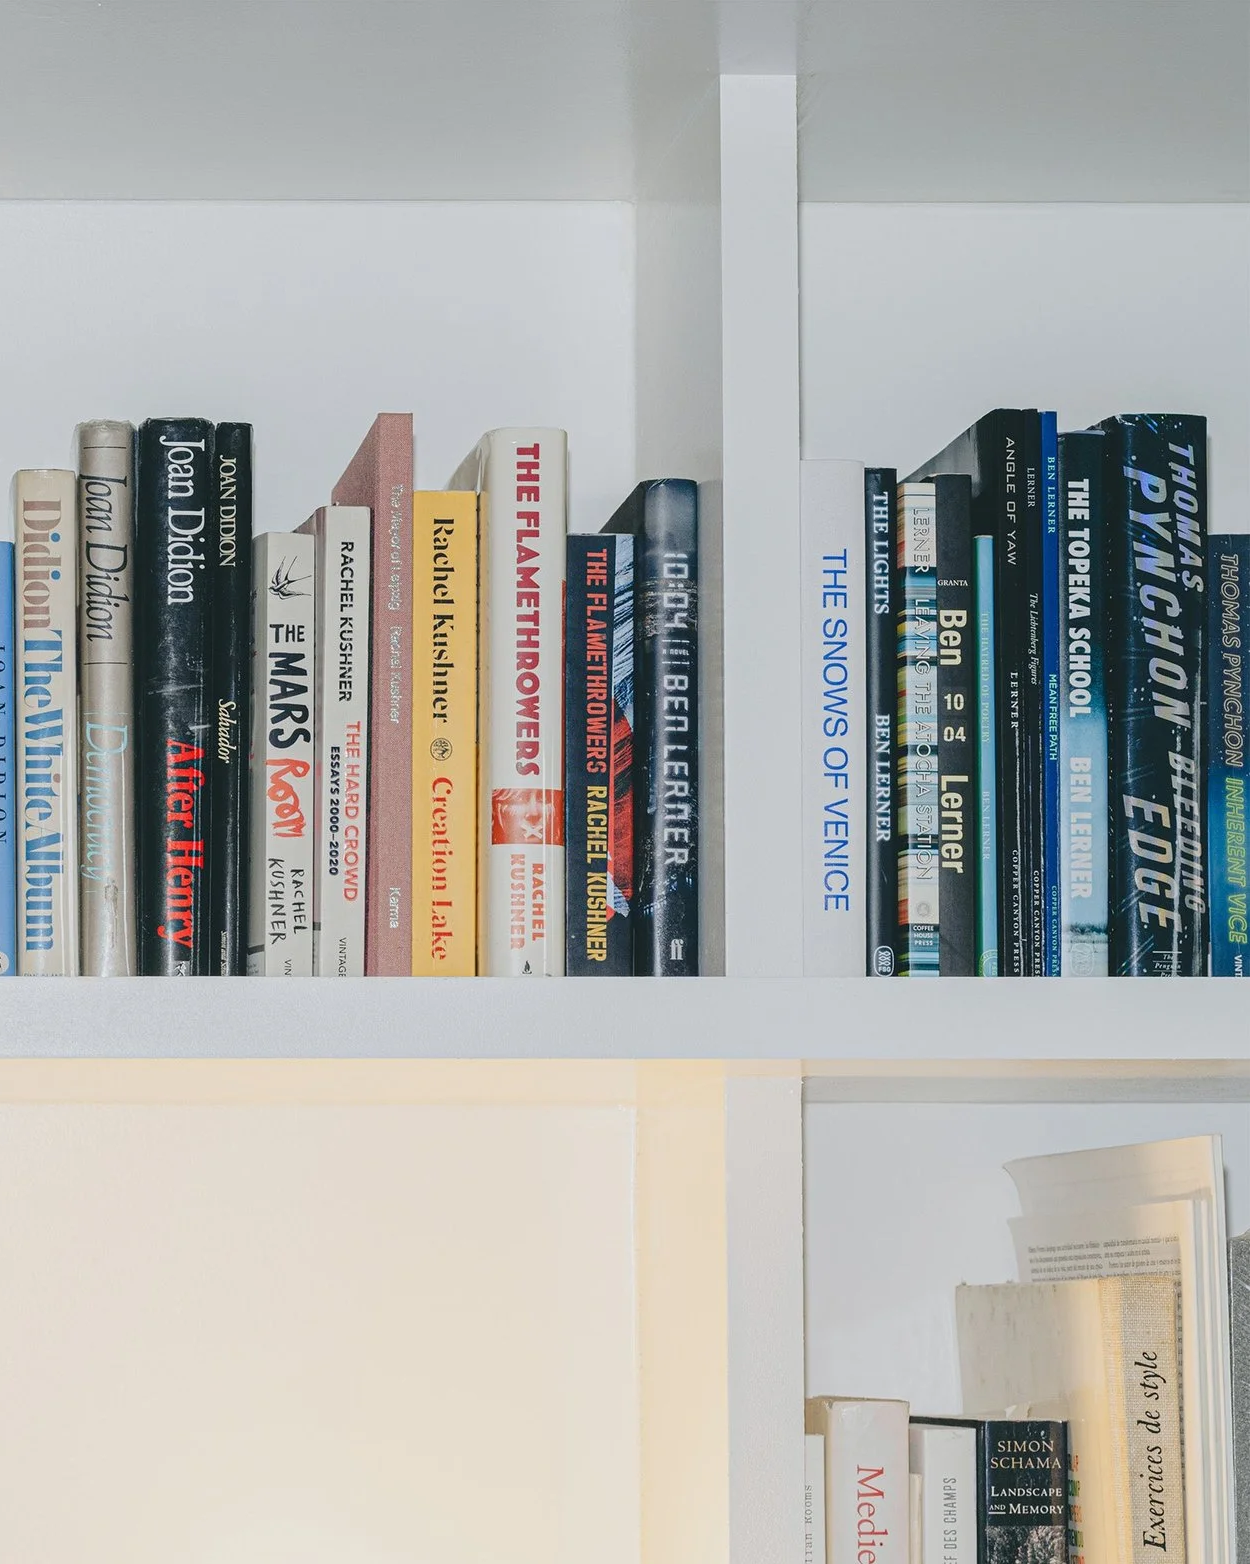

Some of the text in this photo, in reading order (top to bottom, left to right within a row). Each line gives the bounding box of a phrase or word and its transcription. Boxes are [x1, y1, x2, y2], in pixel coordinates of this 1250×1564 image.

[159, 436, 206, 606] Joan Didion
[872, 491, 890, 615] THE LIGHTS
[1006, 437, 1018, 566] ANGLE OF YAW
[269, 623, 306, 643] THE
[338, 541, 355, 702] RACHEL KUSHNER
[433, 518, 455, 724] Rachel Kushner
[515, 443, 540, 777] THE FLAMETHROWERS
[937, 579, 968, 587] GRANTA
[939, 609, 968, 666] Ben
[1068, 478, 1092, 718] THE TOPEKA SCHOOL
[1123, 441, 1205, 729] THOMAS PYNCHON
[217, 698, 237, 765] Salvador
[268, 651, 311, 749] MARS
[822, 549, 850, 911] THE SNOWS OF VENICE
[156, 737, 207, 948] After Henry
[431, 778, 454, 960] Creation Lake
[941, 776, 969, 874] Lerner
[1226, 778, 1247, 944] INHERENT VICE
[990, 1457, 1062, 1469] SCHAMA
[997, 1439, 1055, 1452] SIMON
[1139, 1443, 1168, 1552] Exercices
